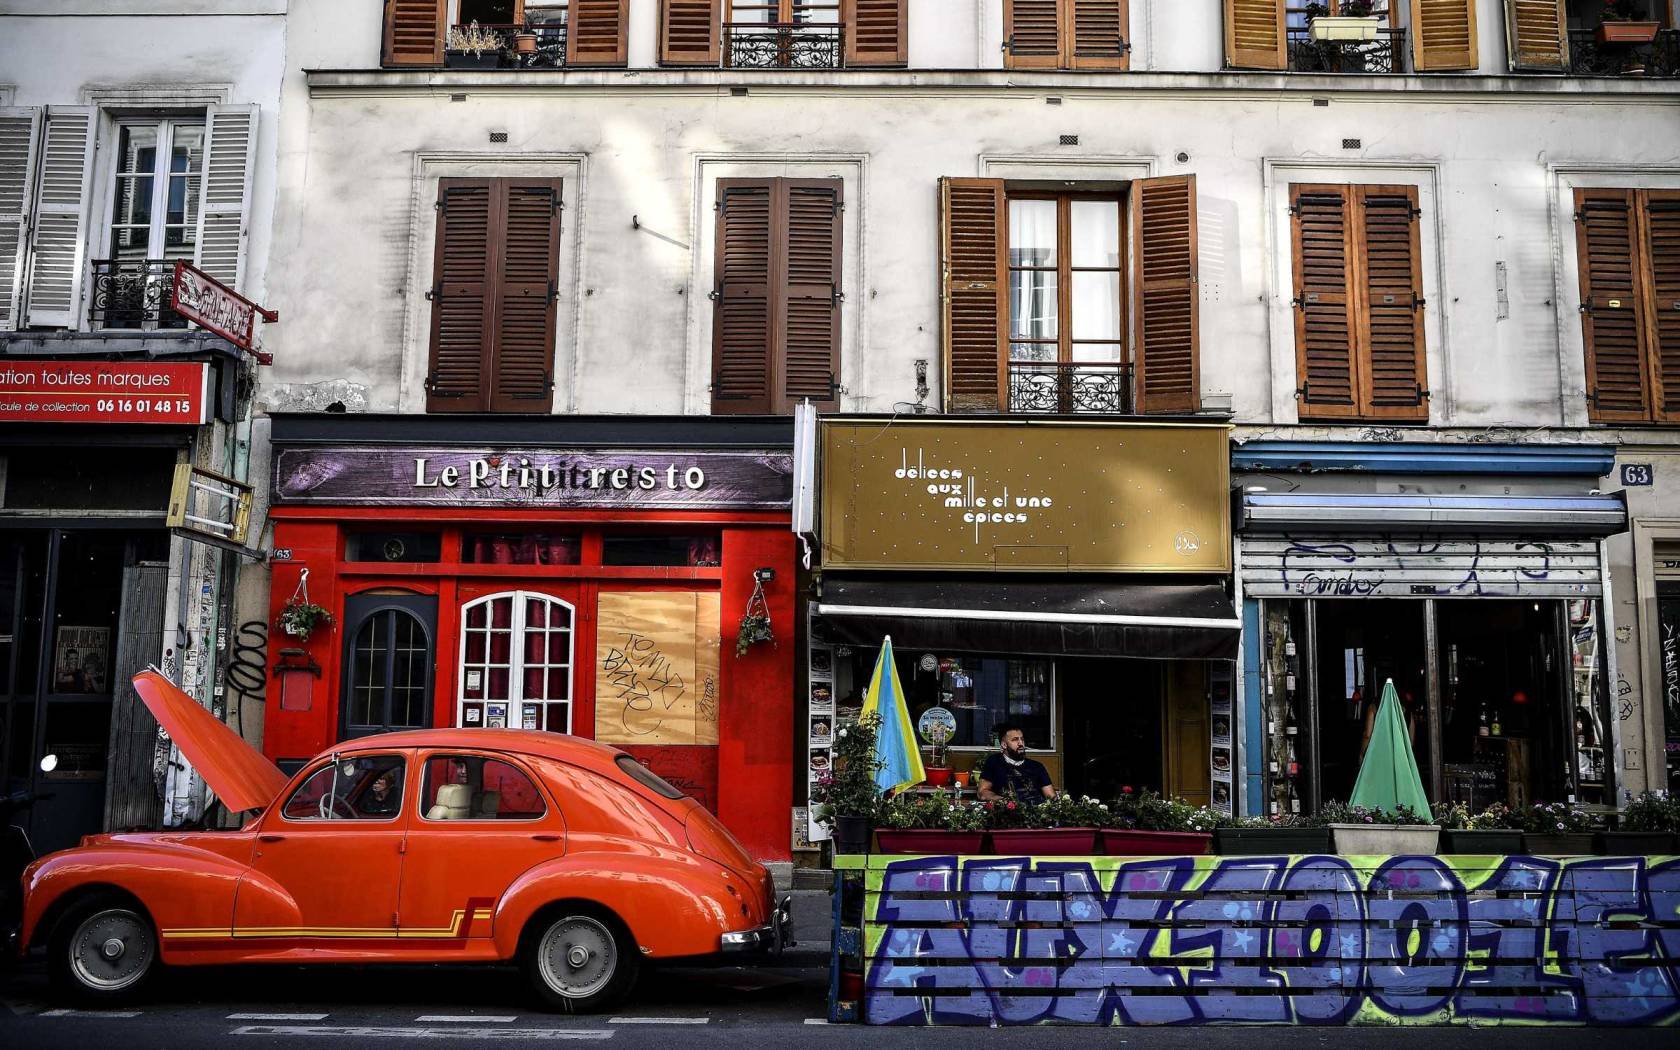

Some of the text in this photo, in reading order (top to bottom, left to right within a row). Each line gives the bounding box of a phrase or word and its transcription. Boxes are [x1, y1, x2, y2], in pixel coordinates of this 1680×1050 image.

[41, 369, 91, 385] toutes
[97, 373, 170, 389] marques
[25, 401, 39, 411] de
[42, 401, 90, 412] collection
[97, 399, 114, 412] 06
[118, 400, 132, 412] 16
[136, 400, 150, 413] 01
[154, 400, 171, 413] 48
[175, 400, 190, 413] 15
[413, 458, 459, 487] Le
[1625, 466, 1648, 483] 63
[926, 484, 963, 495] aux
[944, 475, 1053, 507] mille et une
[276, 549, 290, 559] 63
